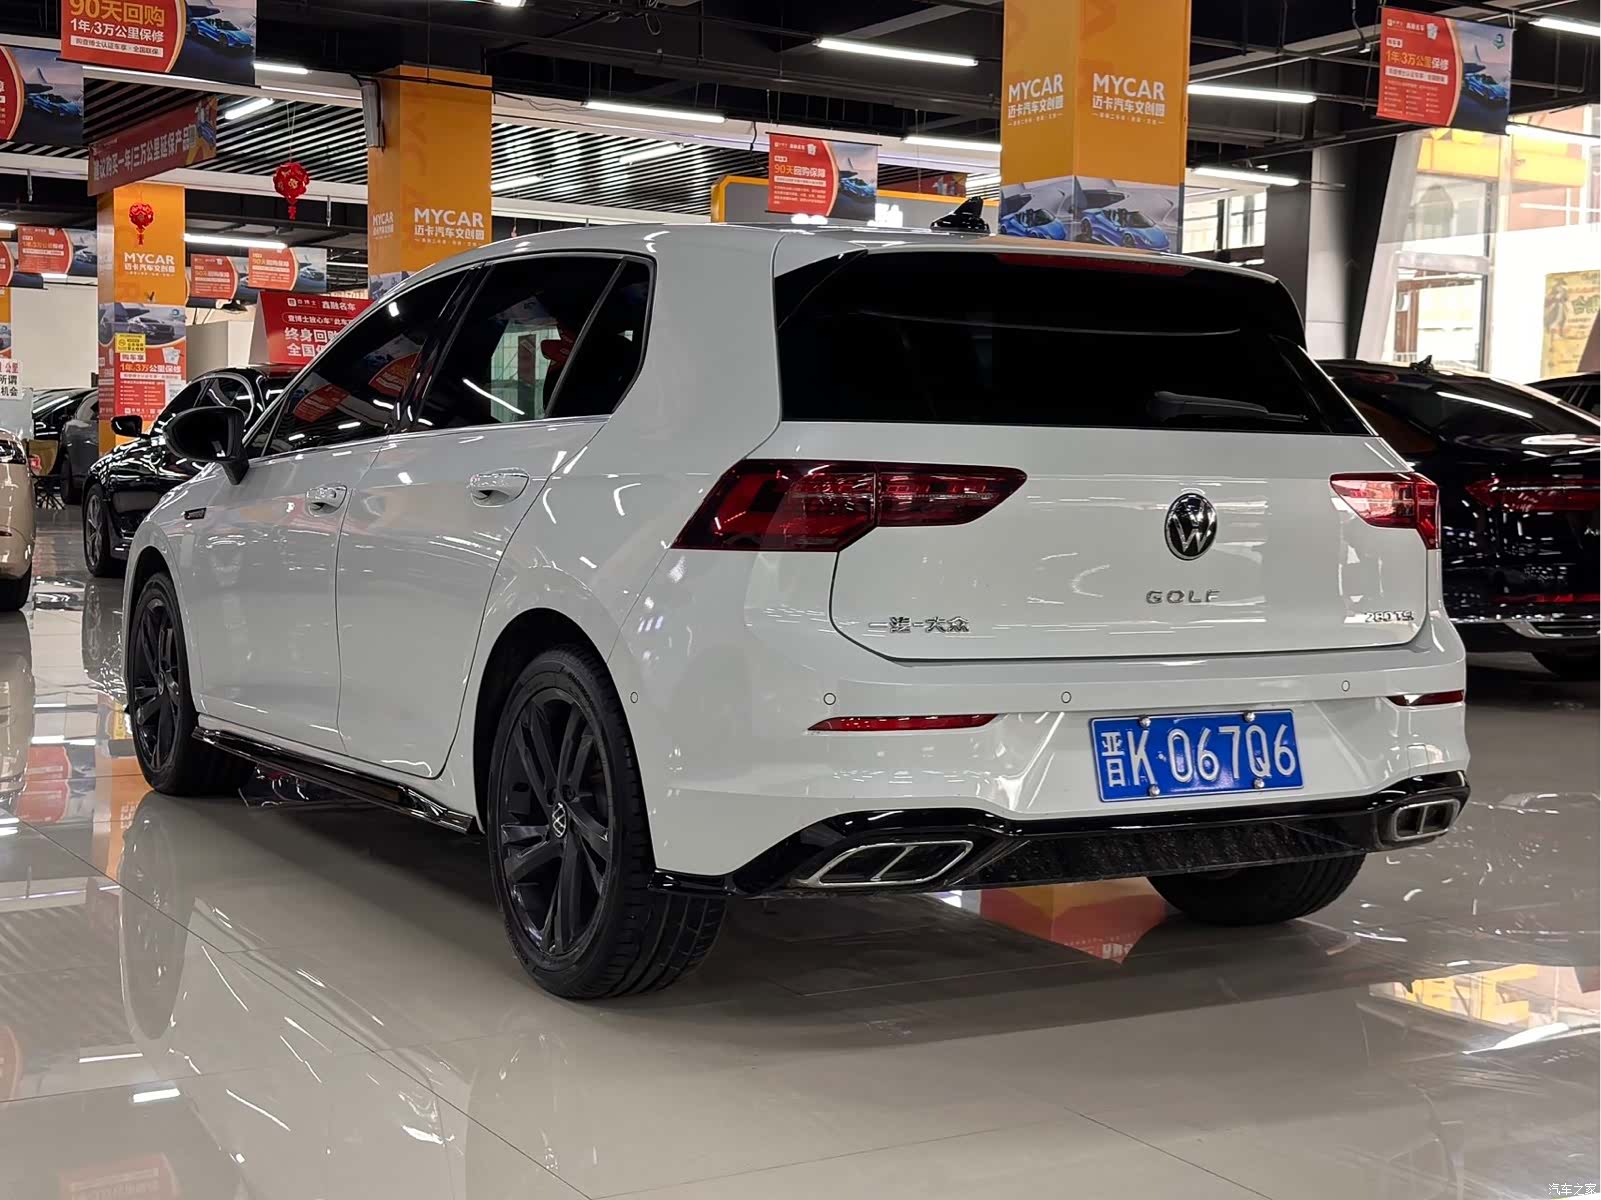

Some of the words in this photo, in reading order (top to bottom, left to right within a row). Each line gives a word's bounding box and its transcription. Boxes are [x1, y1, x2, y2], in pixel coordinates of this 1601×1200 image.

[69, 0, 165, 27] 90天回购
[70, 18, 165, 43] 1年/3万公里保修
[1008, 73, 1064, 103] MYCAR
[1093, 72, 1166, 101] MYCAR
[414, 207, 484, 228] MYCAR
[124, 252, 175, 265] MYCAR
[1, 386, 18, 397] 机会
[1146, 590, 1221, 604] GOLF
[868, 616, 969, 633] 一汽-大众
